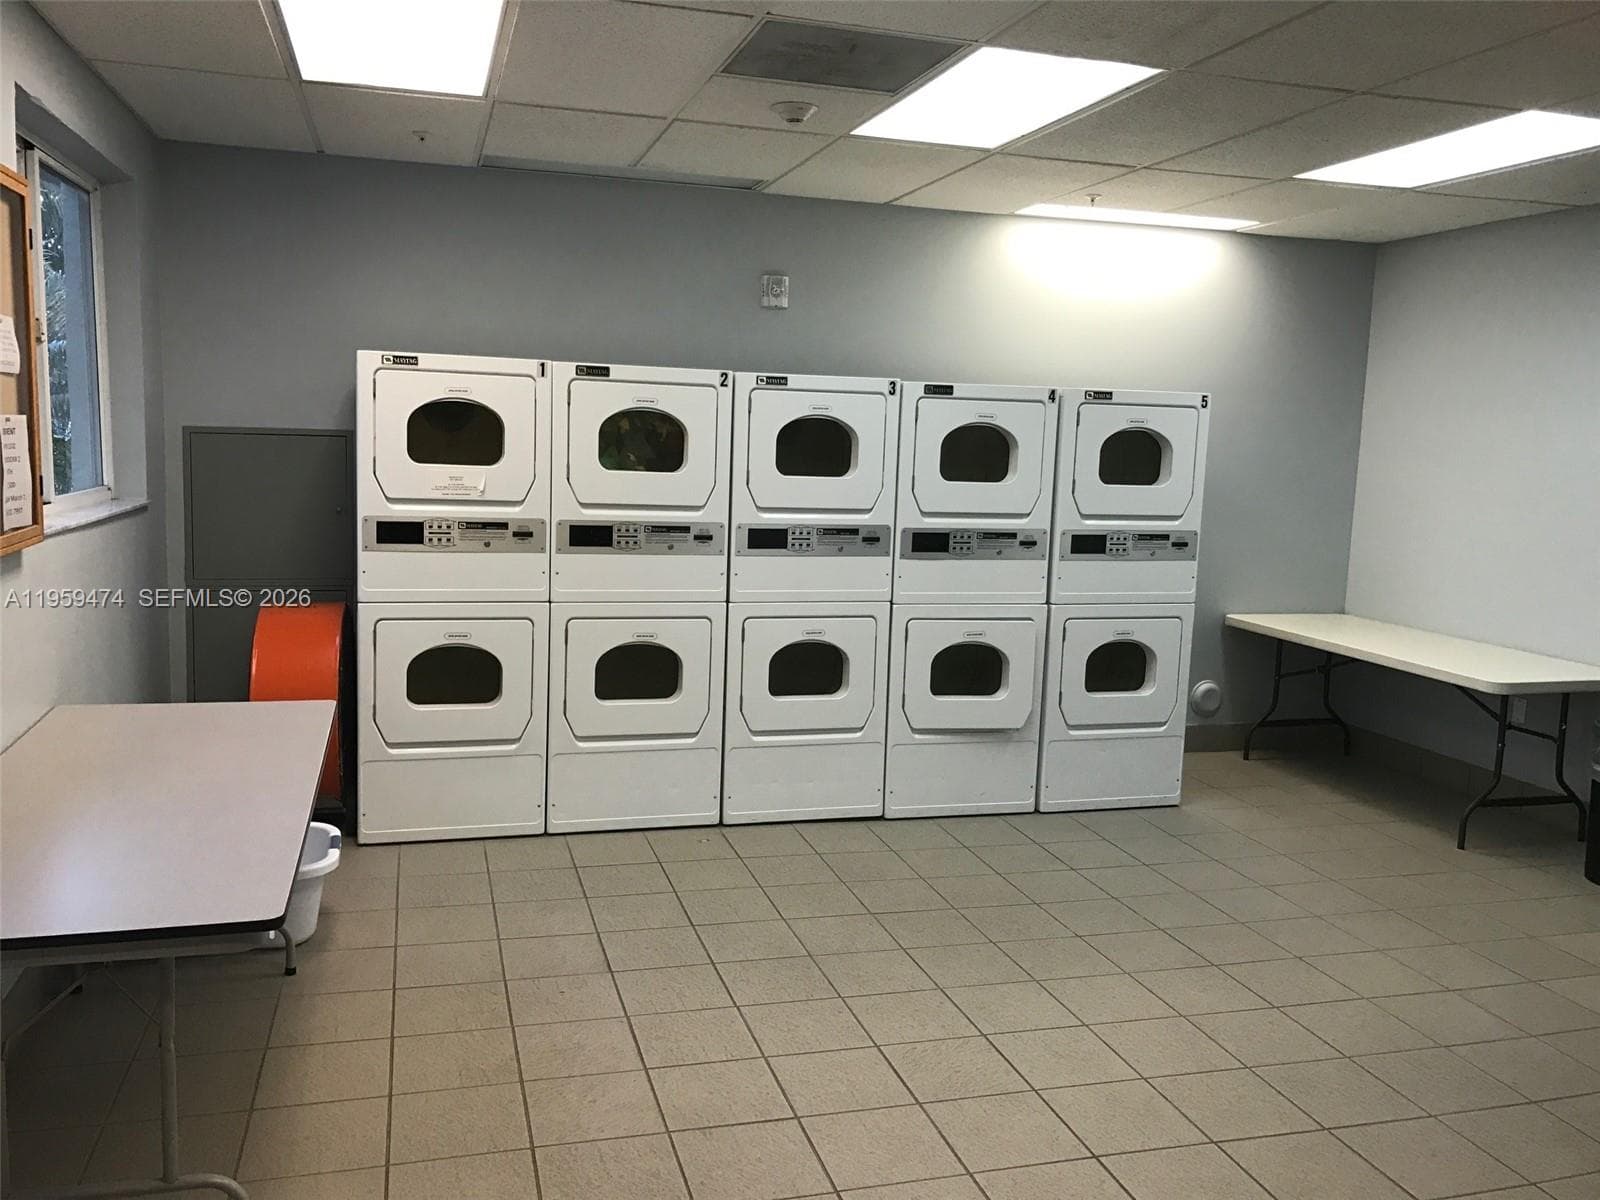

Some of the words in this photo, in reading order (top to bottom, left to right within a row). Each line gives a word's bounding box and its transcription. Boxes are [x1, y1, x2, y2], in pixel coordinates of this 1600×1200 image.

[393, 356, 418, 365] MAYTAG
[539, 362, 546, 377] 1
[719, 372, 729, 387] 2
[888, 381, 896, 396] 3
[1048, 389, 1056, 403] 4
[1201, 395, 1208, 409] 5
